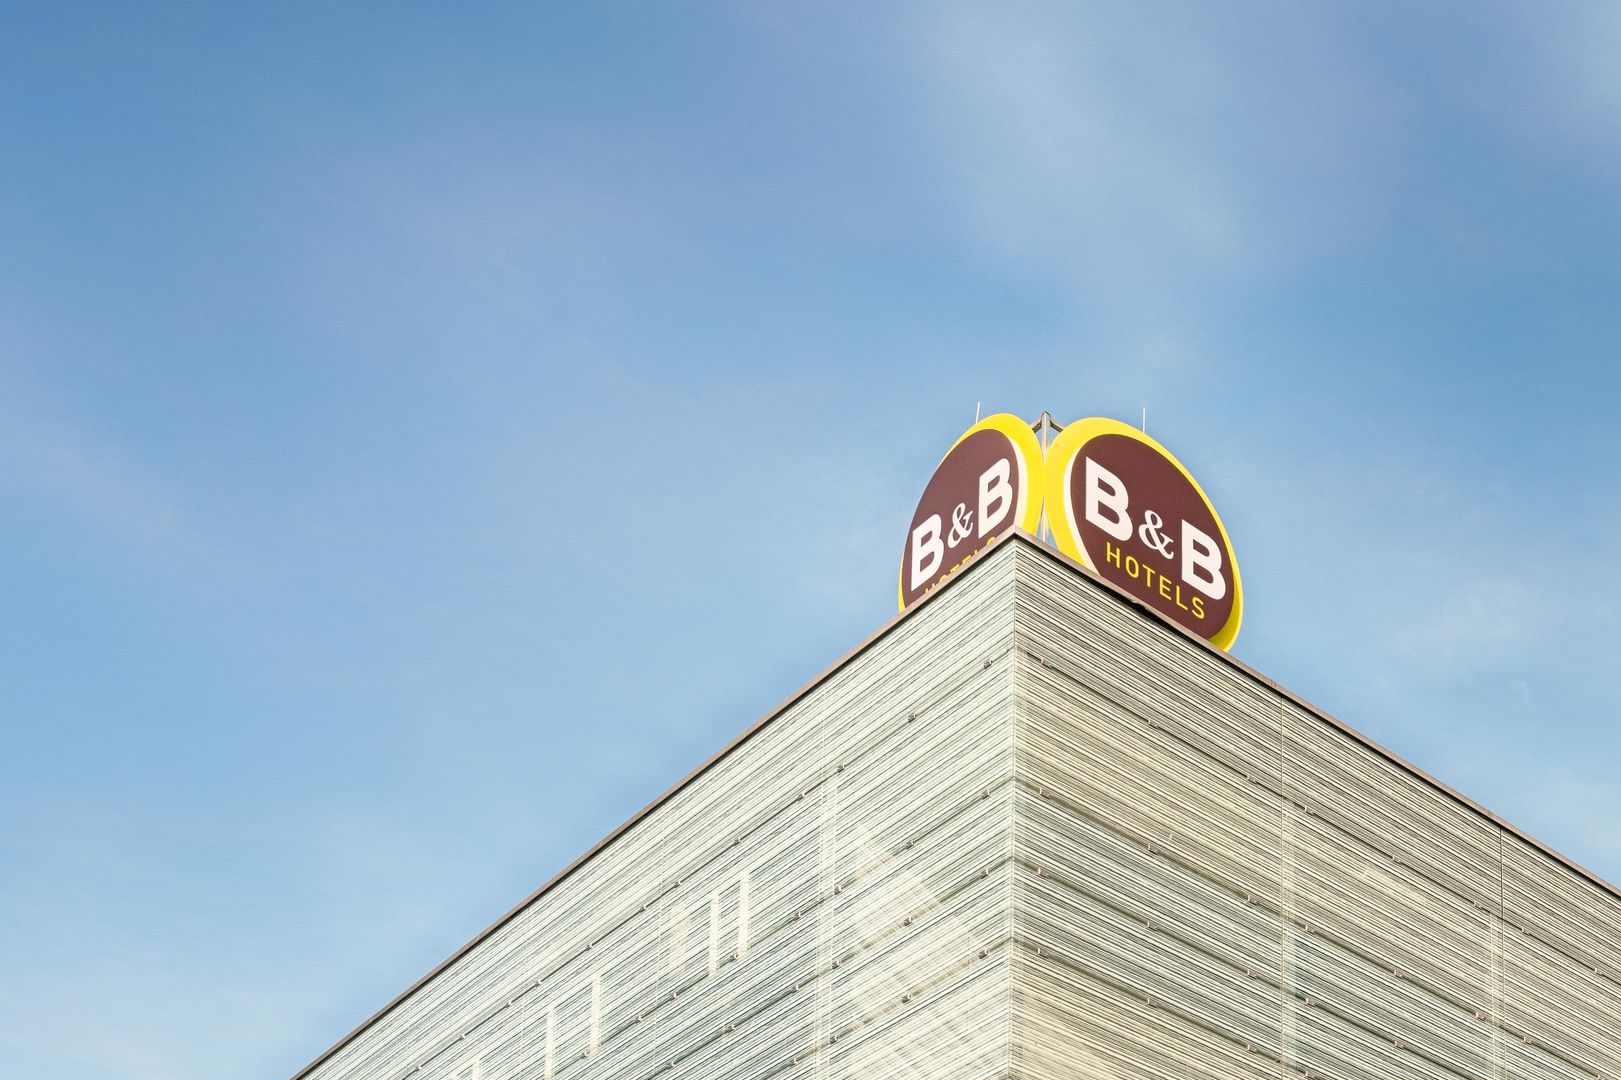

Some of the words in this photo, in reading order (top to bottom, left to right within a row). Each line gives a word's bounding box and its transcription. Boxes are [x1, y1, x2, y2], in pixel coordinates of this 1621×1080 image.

[910, 457, 1014, 591] B&B
[1085, 456, 1226, 600] B&B
[1105, 541, 1206, 620] HOTELS
